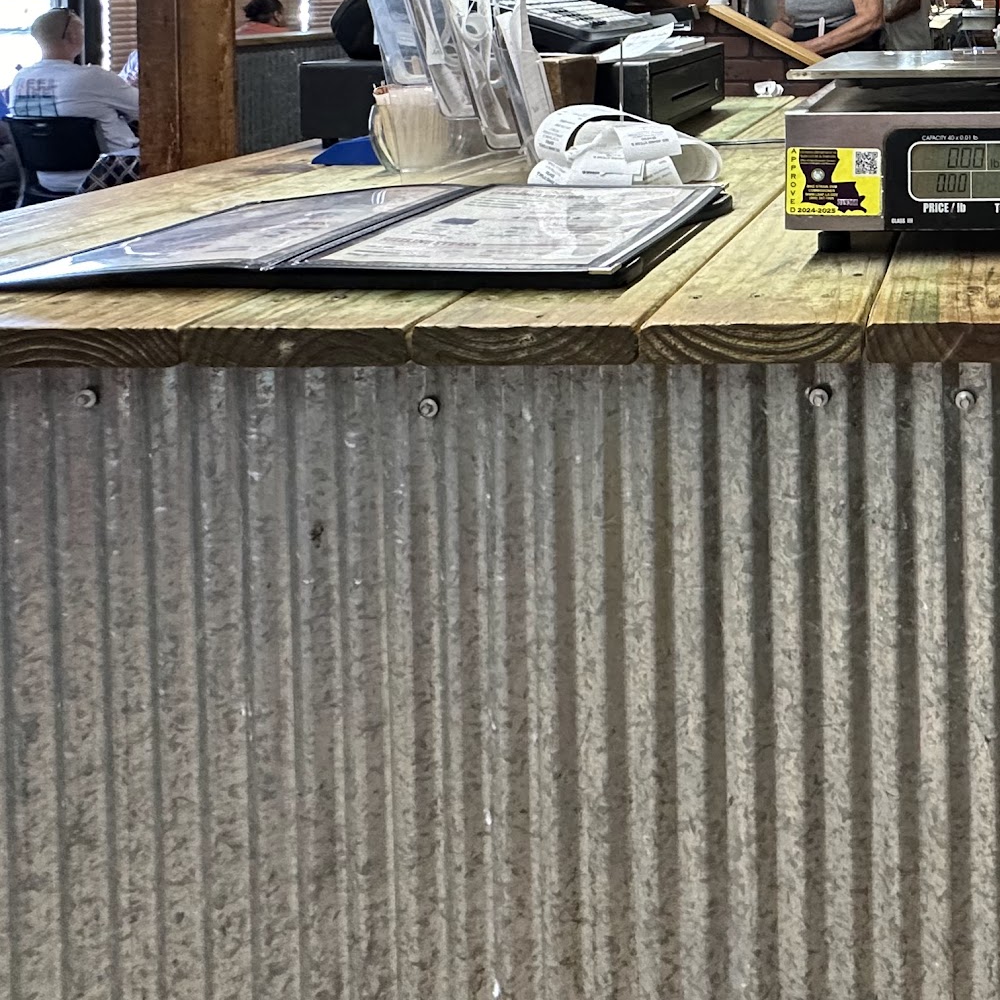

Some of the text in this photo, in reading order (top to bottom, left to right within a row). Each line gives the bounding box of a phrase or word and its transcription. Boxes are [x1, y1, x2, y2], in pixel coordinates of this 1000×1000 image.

[947, 147, 985, 168] 0.00
[990, 158, 1000, 168] lb
[936, 173, 967, 193] 0.00
[922, 202, 950, 213] PRICE
